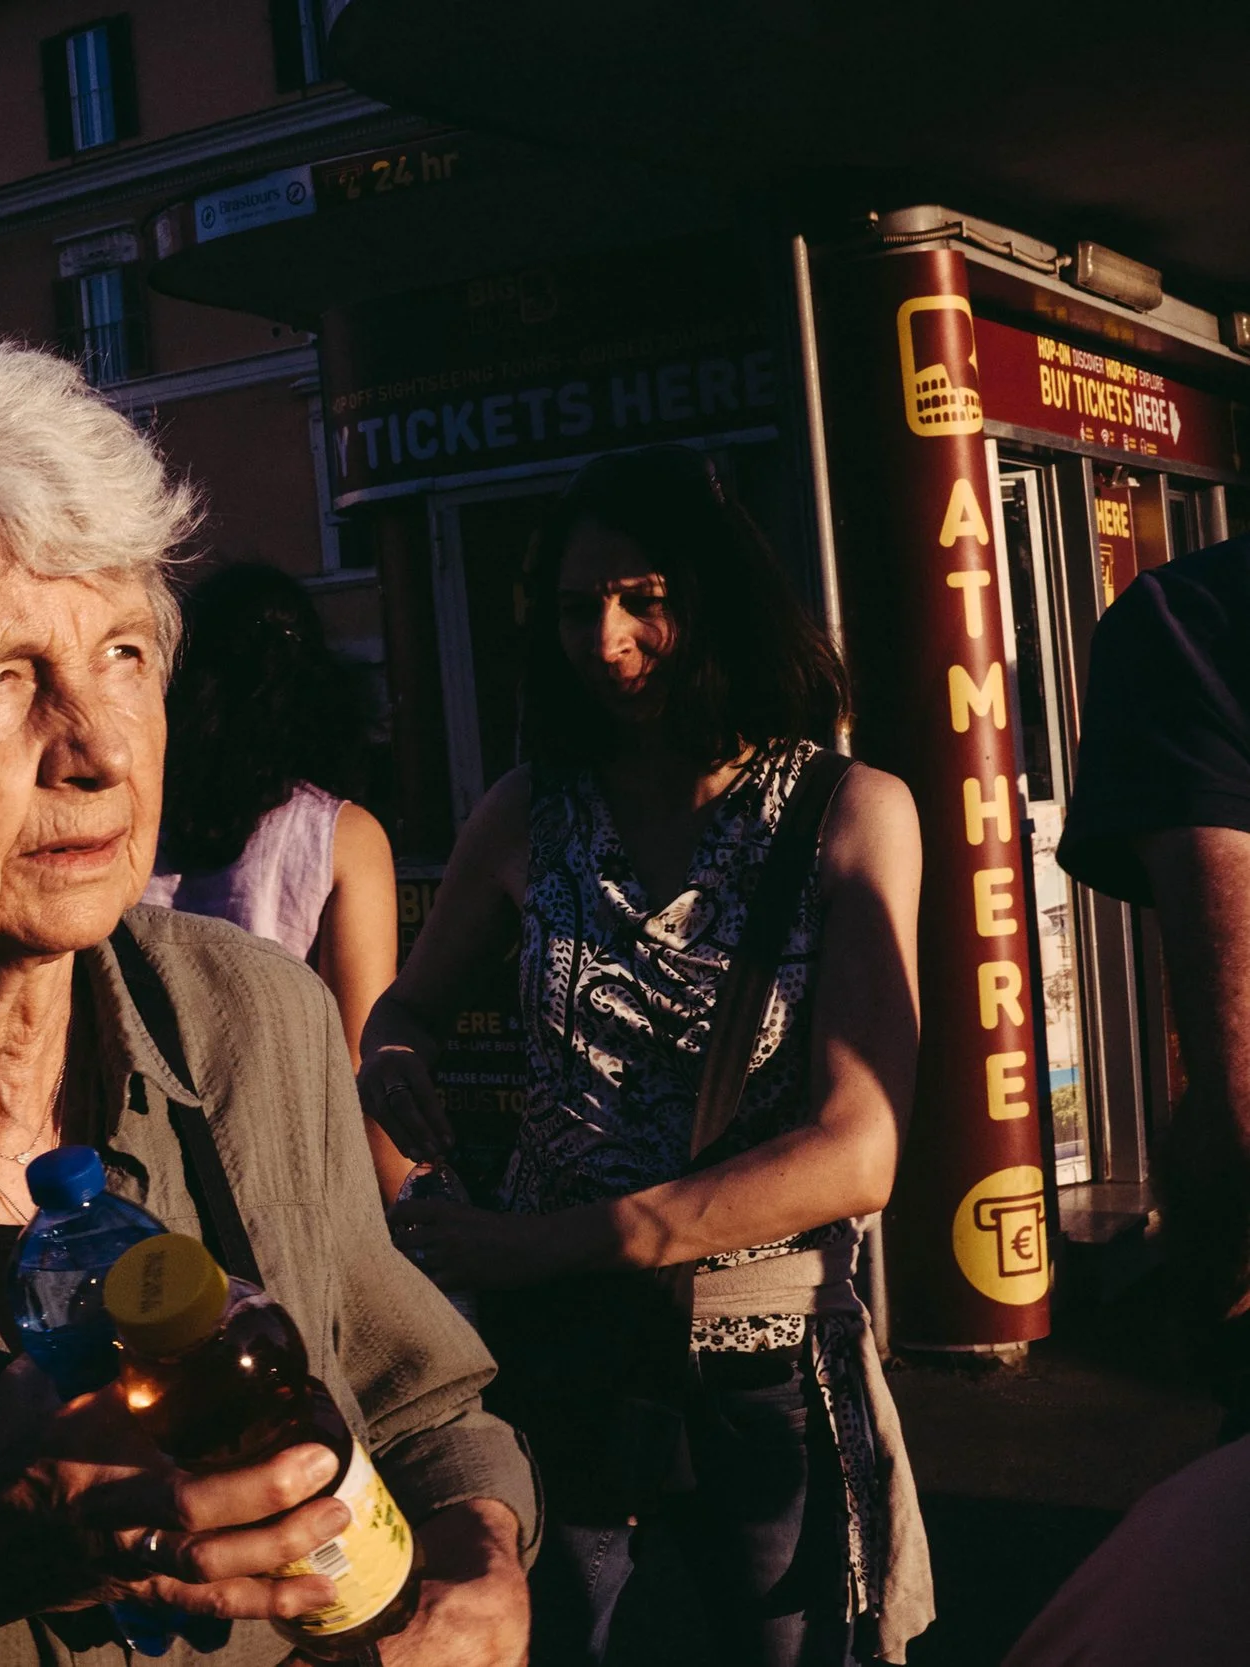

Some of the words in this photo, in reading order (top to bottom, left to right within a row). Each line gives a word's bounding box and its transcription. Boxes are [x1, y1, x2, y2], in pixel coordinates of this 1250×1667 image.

[371, 155, 415, 193] 24
[421, 150, 460, 183] hr
[349, 388, 373, 409] OFF
[378, 366, 494, 402] SIGHTSEEING
[500, 353, 562, 379] TOURS
[1037, 335, 1071, 367] HOP-ON
[1072, 348, 1105, 375] DISCOVER
[1105, 357, 1138, 386] HOP-OFF
[358, 382, 593, 470] TICKETS
[611, 349, 779, 428] HERE
[1039, 364, 1071, 411] BUY
[1073, 374, 1134, 427] TICKETS
[1132, 391, 1170, 436] HERE
[1095, 498, 1131, 539] HERE
[939, 478, 1007, 733] ATM
[962, 774, 1031, 1122] HERE
[456, 1010, 503, 1035] ERE
[470, 1039, 492, 1052] LIVE
[494, 1040, 517, 1053] BUS
[437, 1071, 478, 1085] PLEASE
[479, 1072, 510, 1085] CHAT
[512, 1073, 530, 1086] LIV
